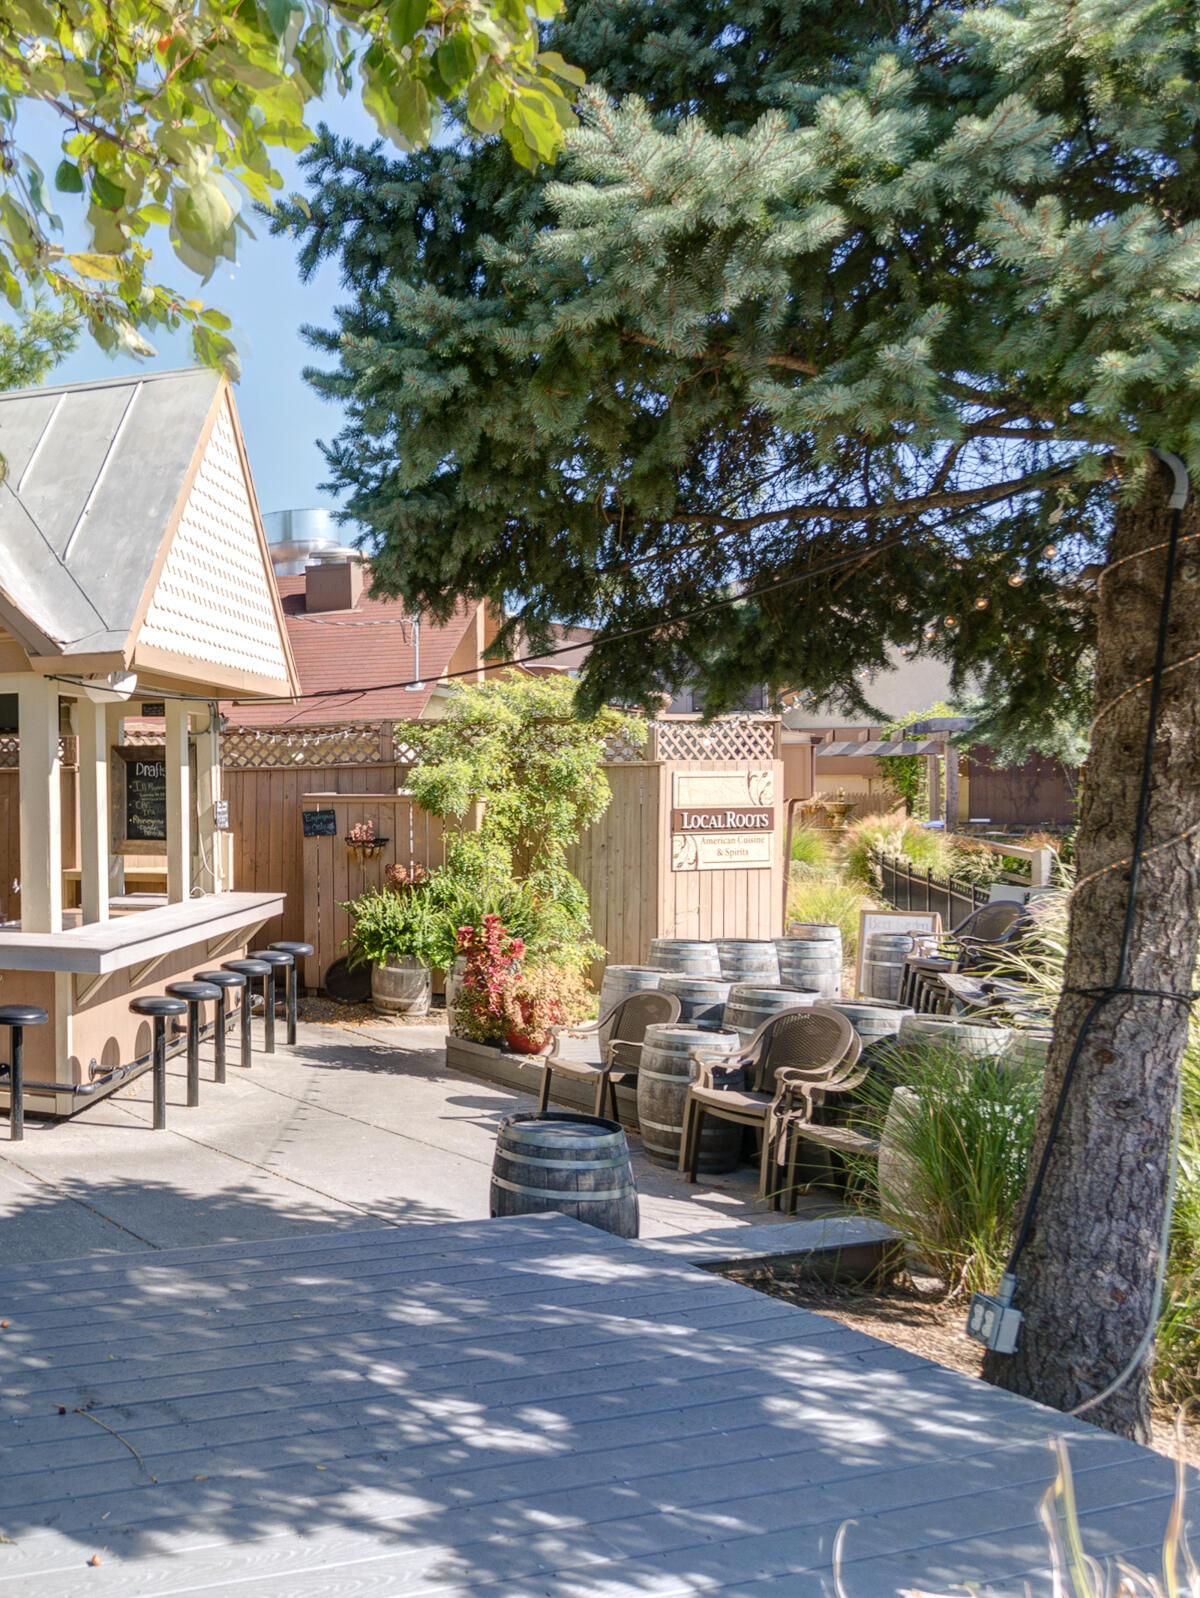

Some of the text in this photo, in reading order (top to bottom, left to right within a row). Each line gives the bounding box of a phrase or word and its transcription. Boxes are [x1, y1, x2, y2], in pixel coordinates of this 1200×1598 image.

[681, 811, 769, 829] LOCAL ROOTS
[700, 836, 765, 845] American Cuisine
[725, 848, 749, 857] Spirits
